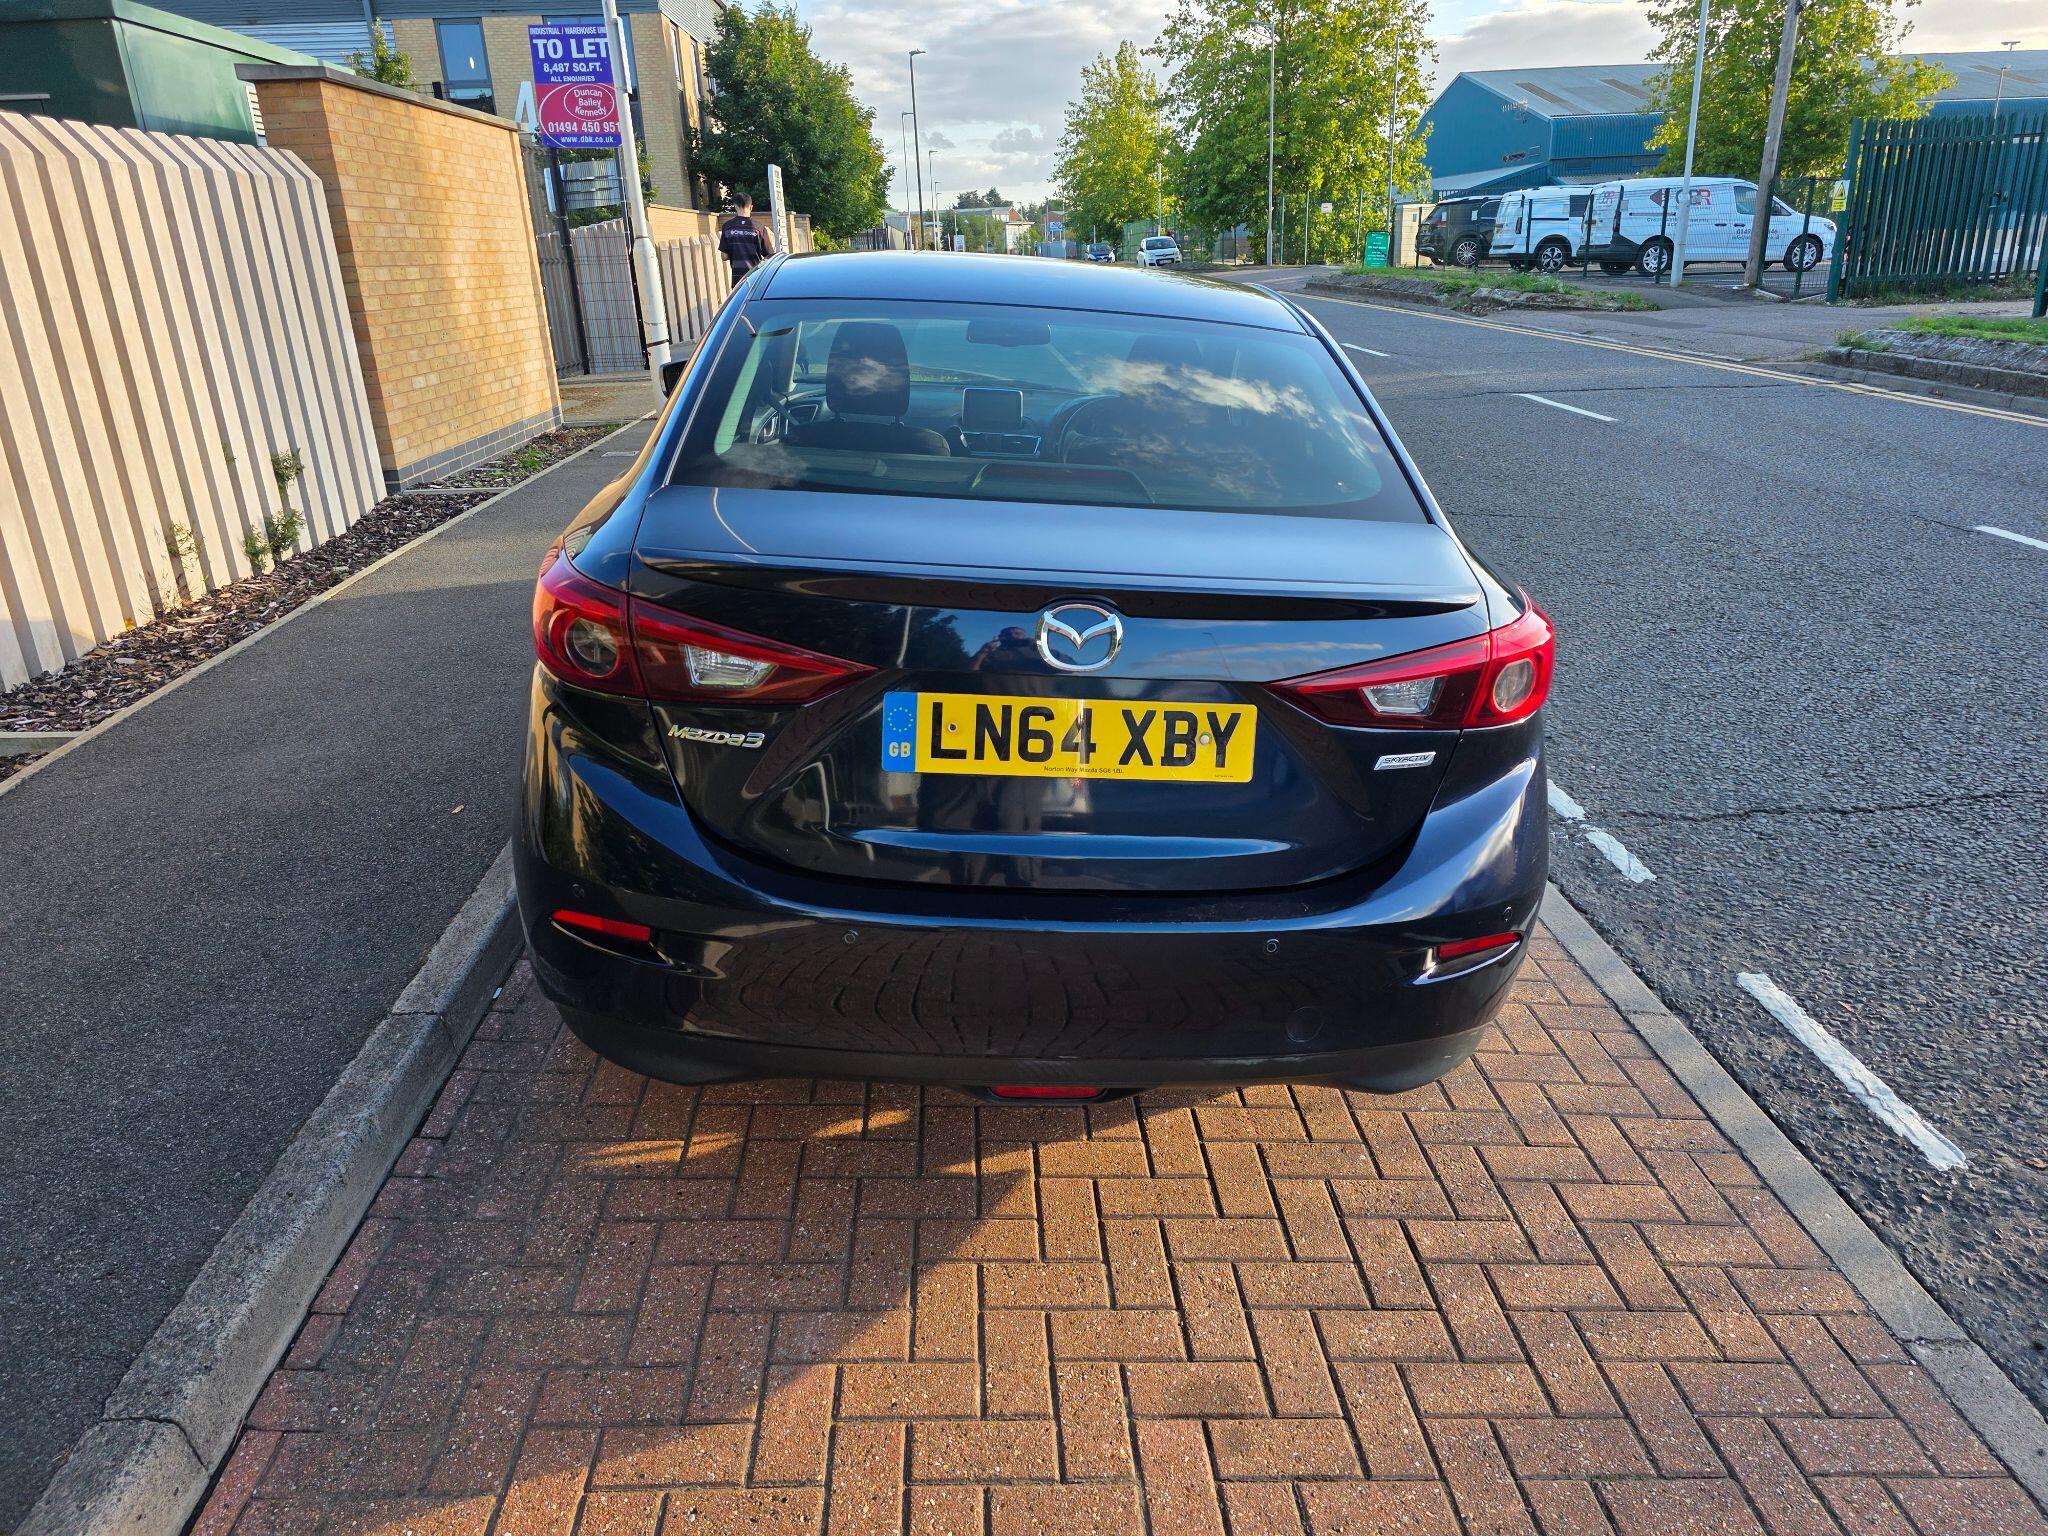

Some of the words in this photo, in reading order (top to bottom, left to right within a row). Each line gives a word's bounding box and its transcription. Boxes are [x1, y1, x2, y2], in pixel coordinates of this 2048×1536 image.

[530, 27, 561, 35] INDUSTRIAL
[565, 26, 597, 35] WAREHOUSE
[533, 38, 563, 59] TO
[570, 37, 609, 59] LET
[543, 62, 570, 74] 8,487
[573, 62, 603, 73] SQ.FT.
[574, 89, 603, 98] Duncan
[578, 97, 602, 107] Bailey
[574, 105, 607, 117] Kennedy
[548, 121, 578, 133] 01494
[581, 121, 600, 133] 450
[603, 120, 621, 133] 951
[560, 135, 614, 143] www.dbk.co.uk
[930, 701, 1096, 765] LN64
[1118, 708, 1242, 769] XBY
[888, 741, 911, 758] GB
[1384, 755, 1430, 763] SKYACTIV
